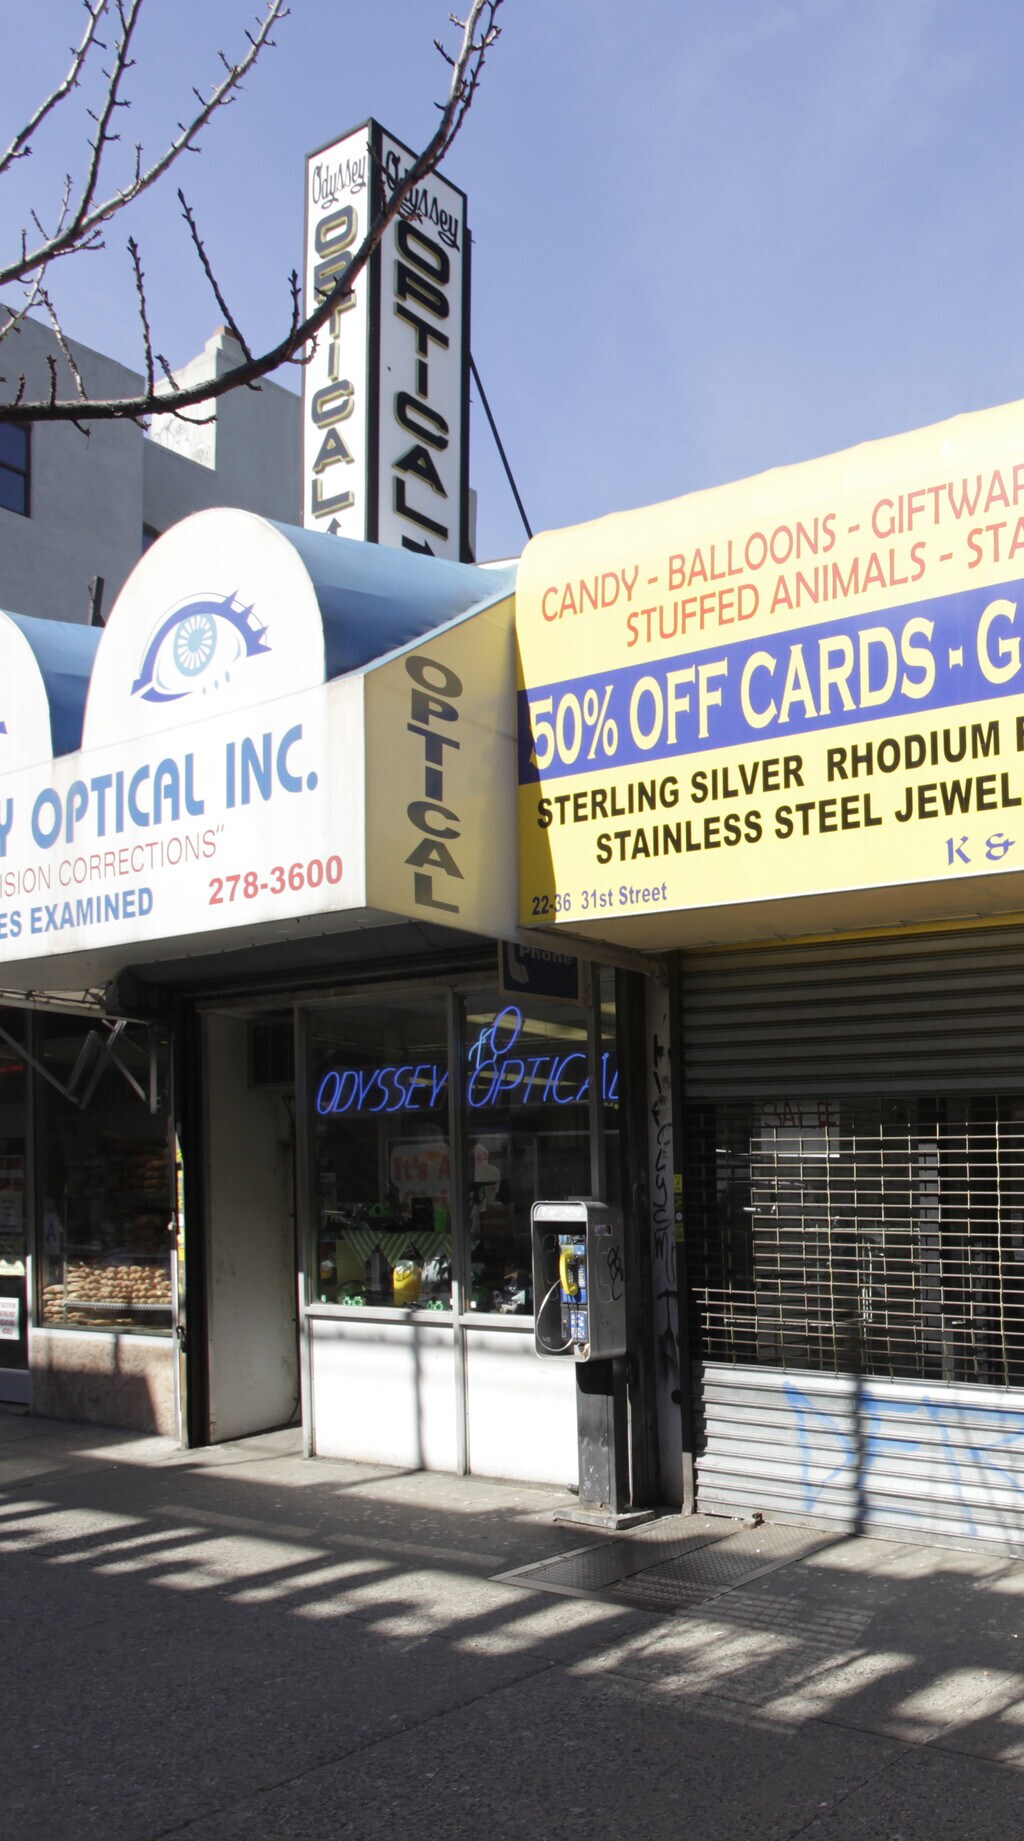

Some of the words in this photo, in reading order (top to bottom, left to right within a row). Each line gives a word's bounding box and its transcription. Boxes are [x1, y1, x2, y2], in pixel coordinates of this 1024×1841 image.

[313, 156, 366, 209] Odyssey
[392, 217, 450, 541] OPTICAL
[541, 565, 640, 622] CANDY
[668, 513, 836, 591] BALLOONS
[627, 583, 759, 647] STUFFED
[769, 542, 926, 614] ANIMALS
[529, 685, 618, 770] 50%
[629, 657, 728, 750] OFF
[740, 617, 936, 728] CARDS
[31, 753, 205, 849] OPTICAL
[225, 724, 319, 810] INC.
[404, 656, 465, 913] OPTICAL
[537, 776, 680, 829] STERLING
[690, 754, 804, 804] SILVER
[827, 719, 1000, 782] RHODIUM
[596, 810, 763, 864] STAINLESS
[774, 792, 882, 840] STEEL
[945, 835, 972, 866] K
[984, 832, 1015, 861] &
[30, 887, 154, 934] EXAMINED
[208, 855, 343, 905] 278-3600
[532, 893, 571, 915] 22-36
[581, 887, 613, 911] 31st
[619, 882, 668, 906] Street
[316, 1065, 448, 1115] ODYSSEY
